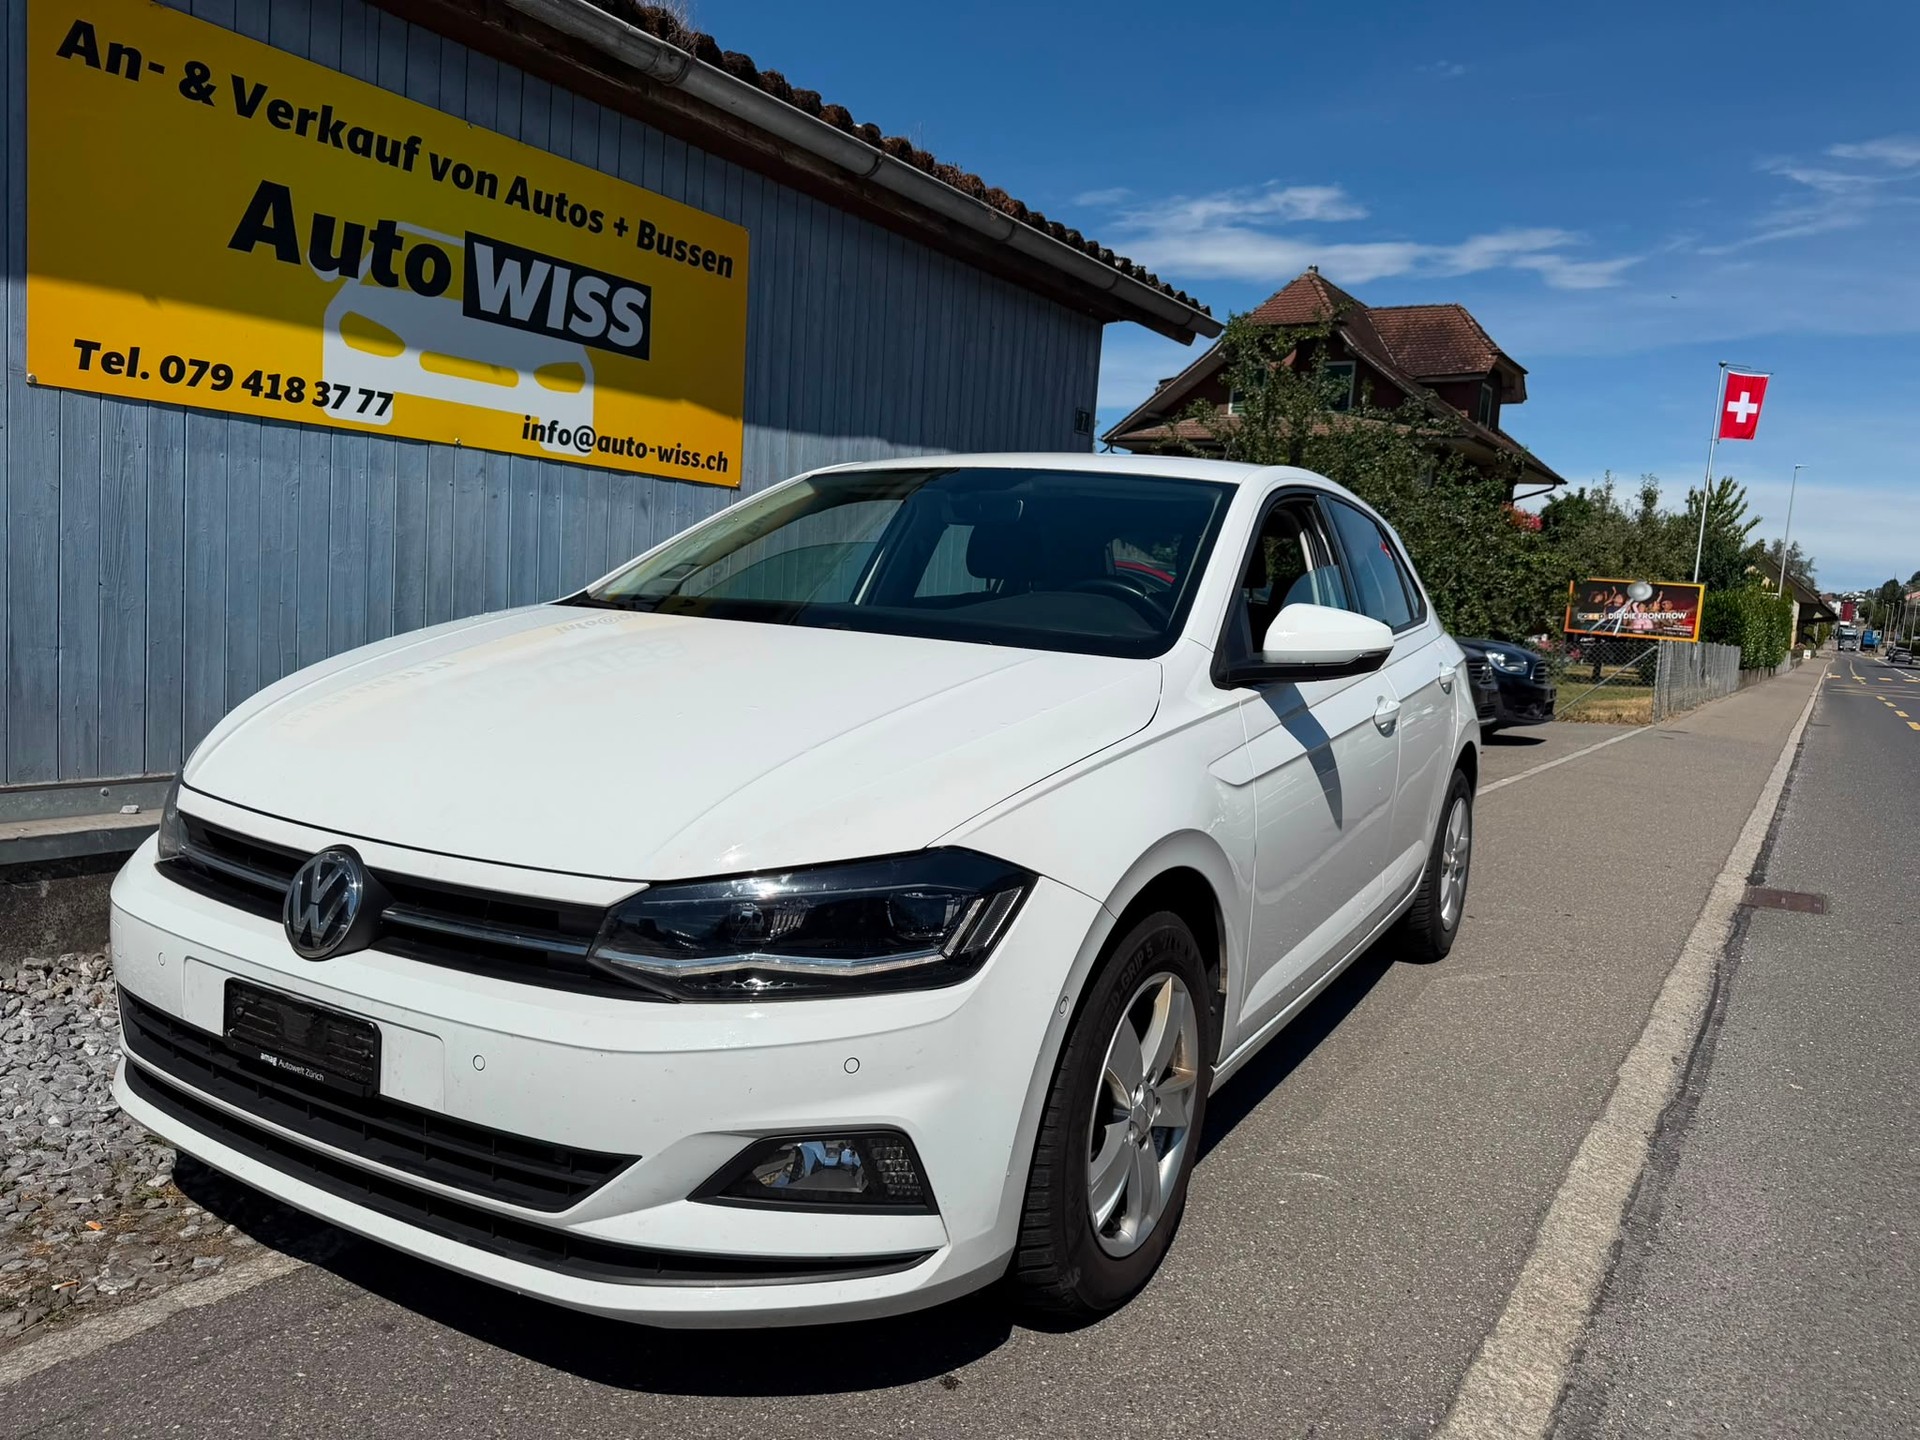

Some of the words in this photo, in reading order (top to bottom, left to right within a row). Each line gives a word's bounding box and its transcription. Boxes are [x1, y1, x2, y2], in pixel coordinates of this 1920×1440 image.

[56, 19, 165, 82] An-
[178, 60, 217, 107] &
[231, 73, 422, 172] Verkauf
[429, 152, 498, 200] von
[505, 175, 605, 234] Autos
[613, 217, 629, 238] +
[636, 219, 733, 279] Bussen
[227, 179, 452, 298] Auto
[473, 241, 647, 348] WISS
[73, 338, 150, 380] Tel.
[159, 354, 234, 391] 079
[241, 369, 306, 404] 418
[311, 381, 351, 410] 37
[356, 387, 394, 417] 77
[522, 415, 728, 473] info@auto-wiss.ch
[1638, 611, 1687, 620] FRONTROW
[287, 854, 359, 953] VW
[260, 1052, 278, 1067] amag
[278, 1059, 305, 1075] Autowelt
[305, 1068, 325, 1082] Zürich
